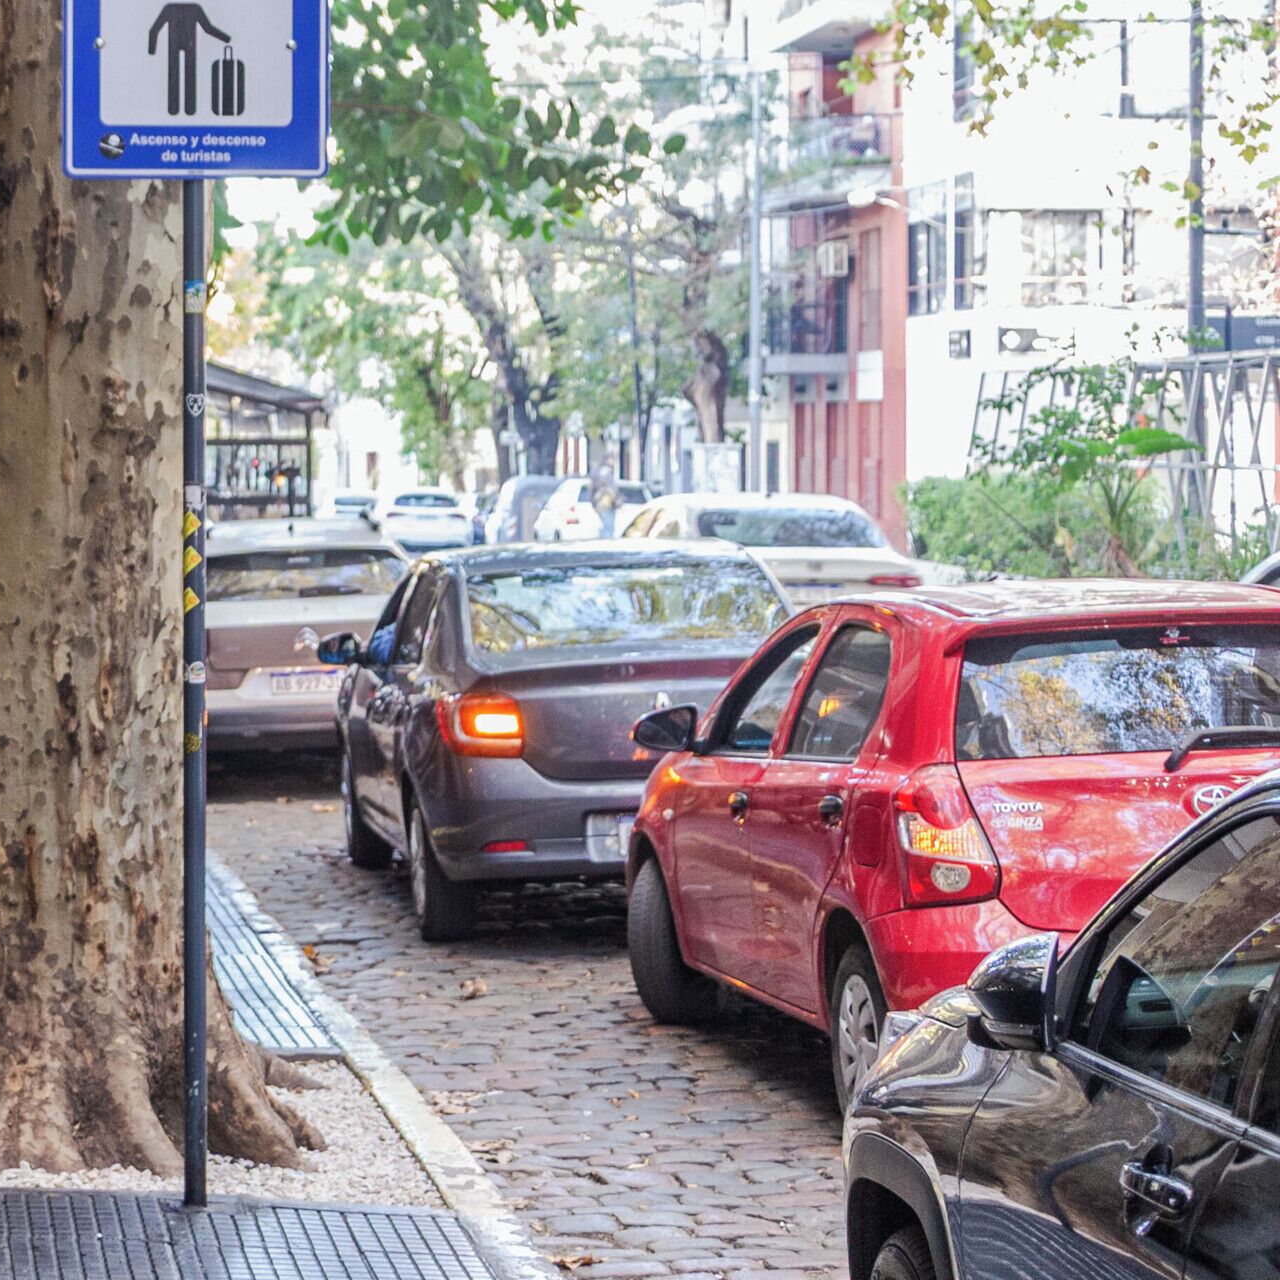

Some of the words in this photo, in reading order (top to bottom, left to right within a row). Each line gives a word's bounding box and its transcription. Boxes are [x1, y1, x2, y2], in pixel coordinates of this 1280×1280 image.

[129, 132, 188, 146] Ascenso
[190, 135, 200, 148] y
[202, 133, 267, 146] descenso
[161, 149, 178, 162] de
[180, 150, 231, 163] turistas
[993, 801, 1044, 814] TOYOTA
